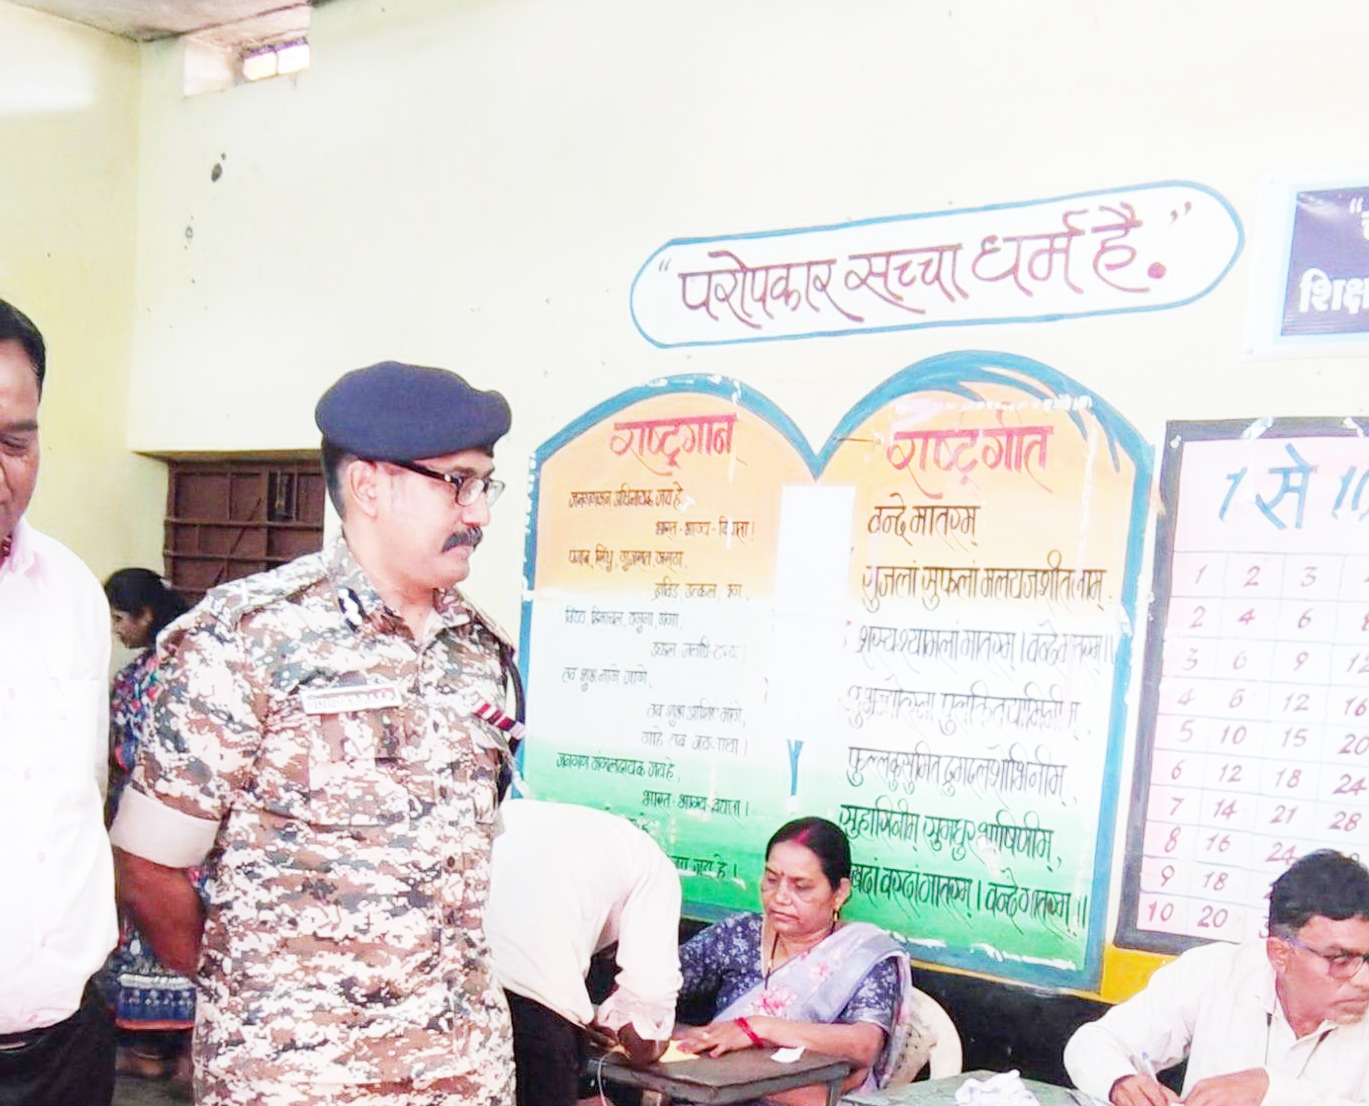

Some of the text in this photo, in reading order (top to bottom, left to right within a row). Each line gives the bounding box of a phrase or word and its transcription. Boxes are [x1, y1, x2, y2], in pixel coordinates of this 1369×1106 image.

[844, 242, 969, 315] सच्चा
[973, 209, 1087, 298] धर्म
[1255, 442, 1319, 531] से
[1194, 564, 1208, 585] 1
[1243, 565, 1261, 587] 2
[1300, 566, 1318, 587] 3
[1189, 605, 1205, 629] 2
[1237, 608, 1256, 625] 4
[1297, 608, 1314, 629] 6
[1182, 647, 1198, 671] 3
[1293, 651, 1309, 672] 9
[1283, 693, 1310, 713] 12
[1343, 696, 1369, 717] 16
[1178, 719, 1195, 743] 5
[1220, 724, 1247, 745] 10
[1282, 727, 1309, 748] 15
[1171, 759, 1186, 780] 6
[1218, 763, 1243, 783] 12
[1275, 768, 1303, 789] 18
[1332, 774, 1368, 796] 24
[1169, 797, 1185, 816] 7
[1212, 798, 1238, 820] 14
[1269, 805, 1299, 825] 21
[1328, 811, 1362, 832] 28
[1165, 826, 1181, 853] 8
[1206, 833, 1231, 853] 16
[1264, 841, 1298, 866] 24
[1161, 865, 1175, 887] 9
[1203, 870, 1229, 892] 18
[1147, 900, 1175, 923] 10
[1197, 905, 1229, 928] 20
